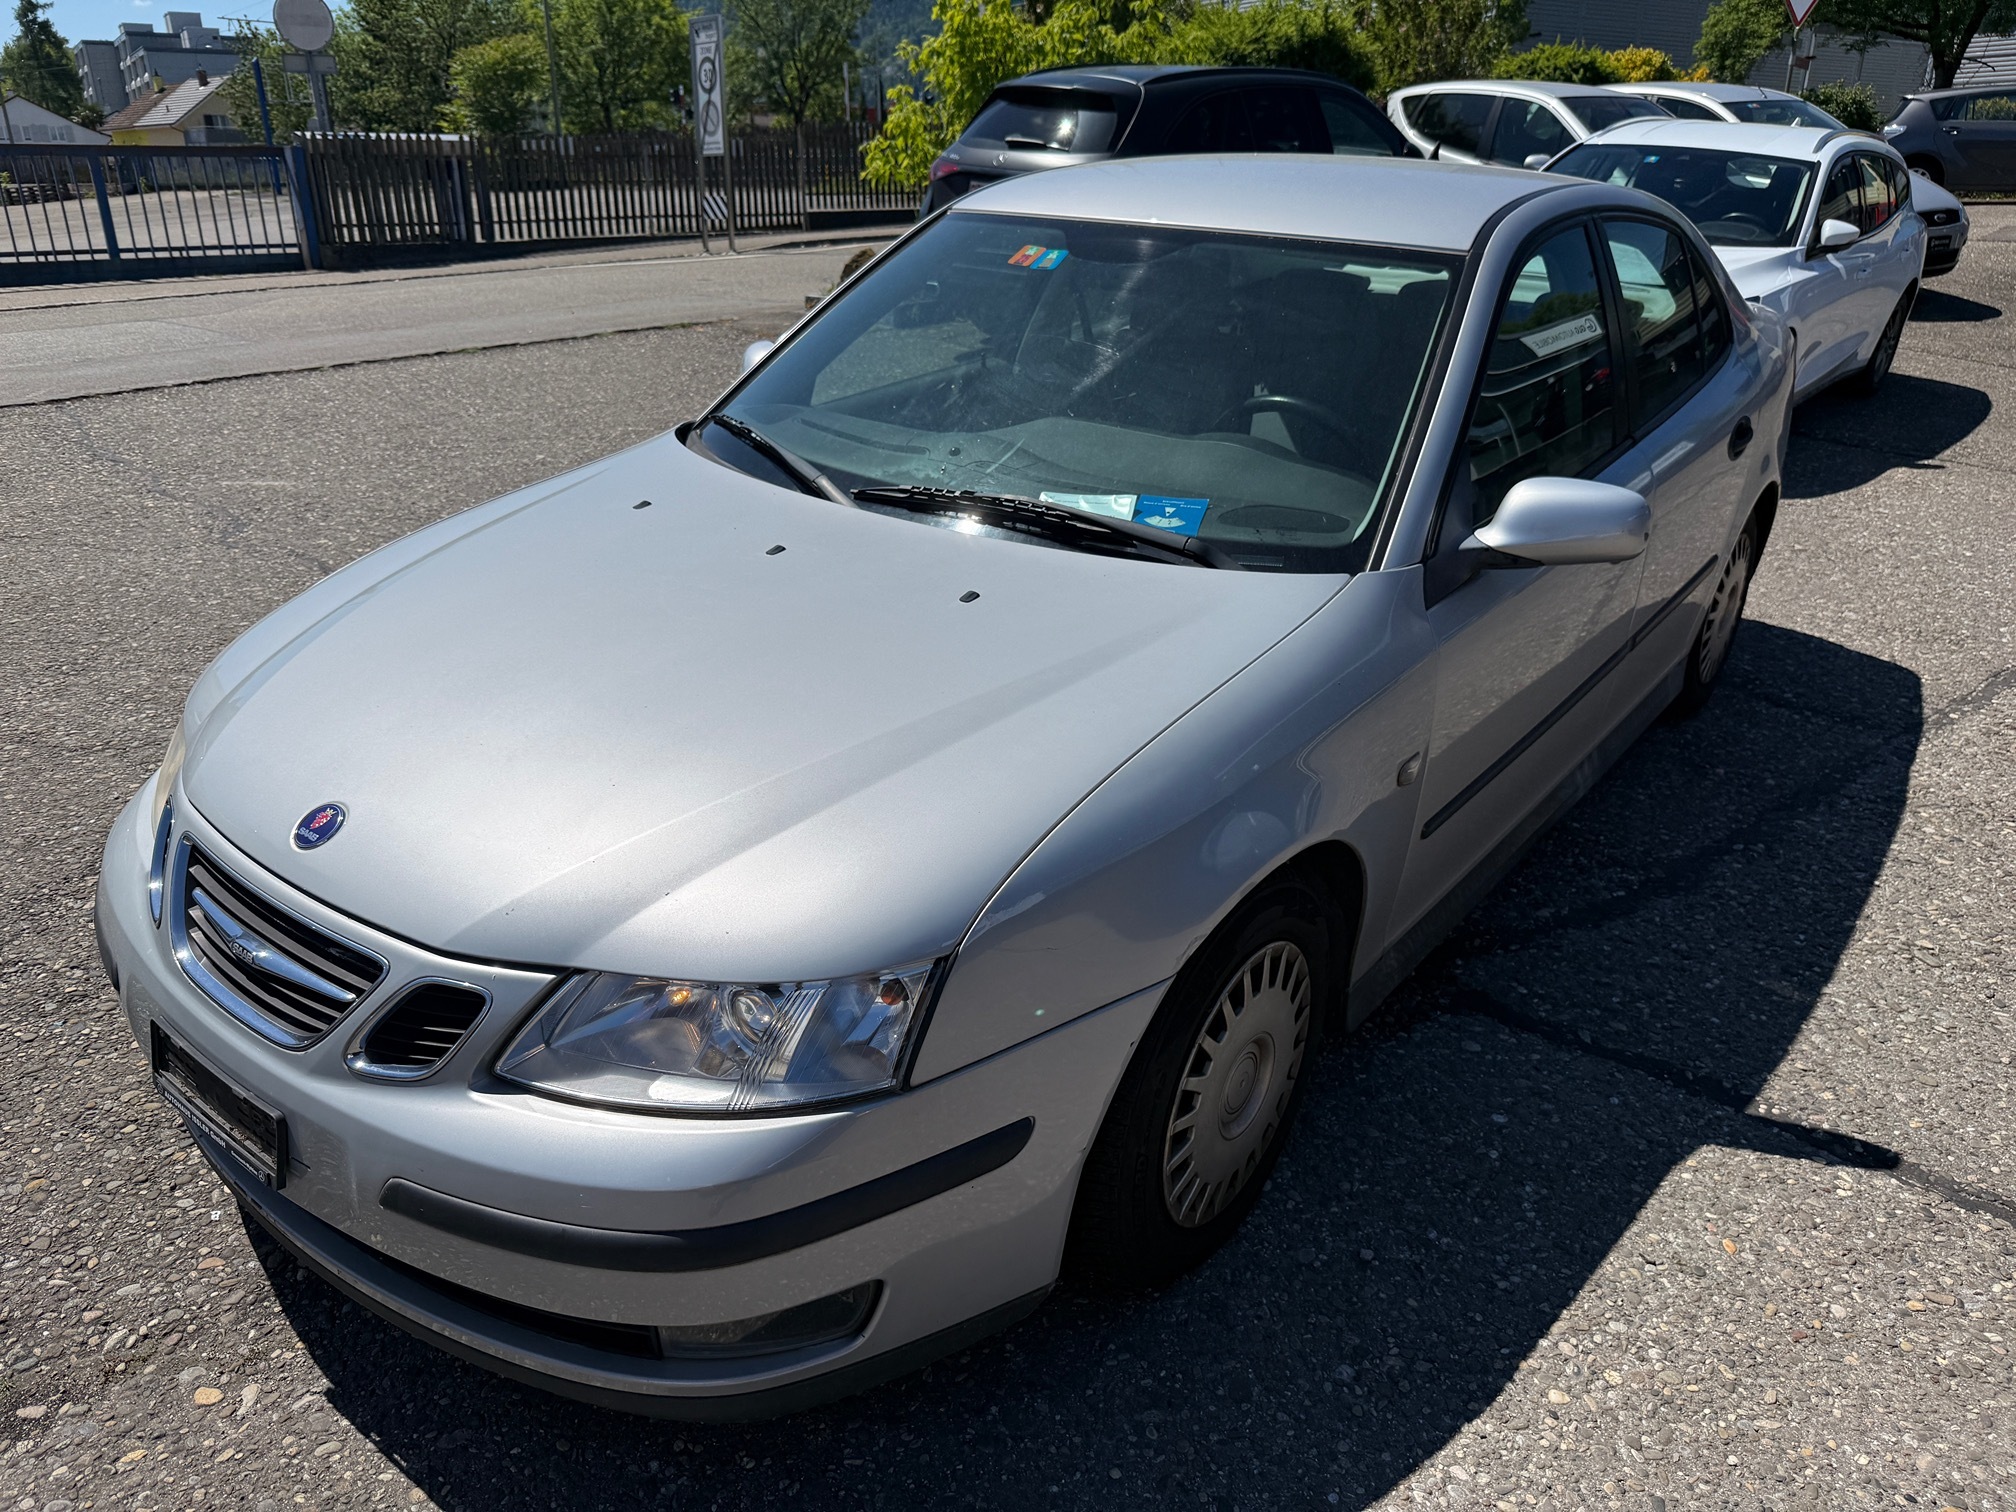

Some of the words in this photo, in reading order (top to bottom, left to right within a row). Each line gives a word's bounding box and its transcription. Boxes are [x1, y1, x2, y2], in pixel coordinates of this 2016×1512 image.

[298, 827, 319, 842] SAAB
[232, 942, 254, 965] SAAB
[164, 1090, 191, 1118] AUTOHAUS
[191, 1114, 210, 1135] ISSLER
[210, 1130, 226, 1148] GmbH
